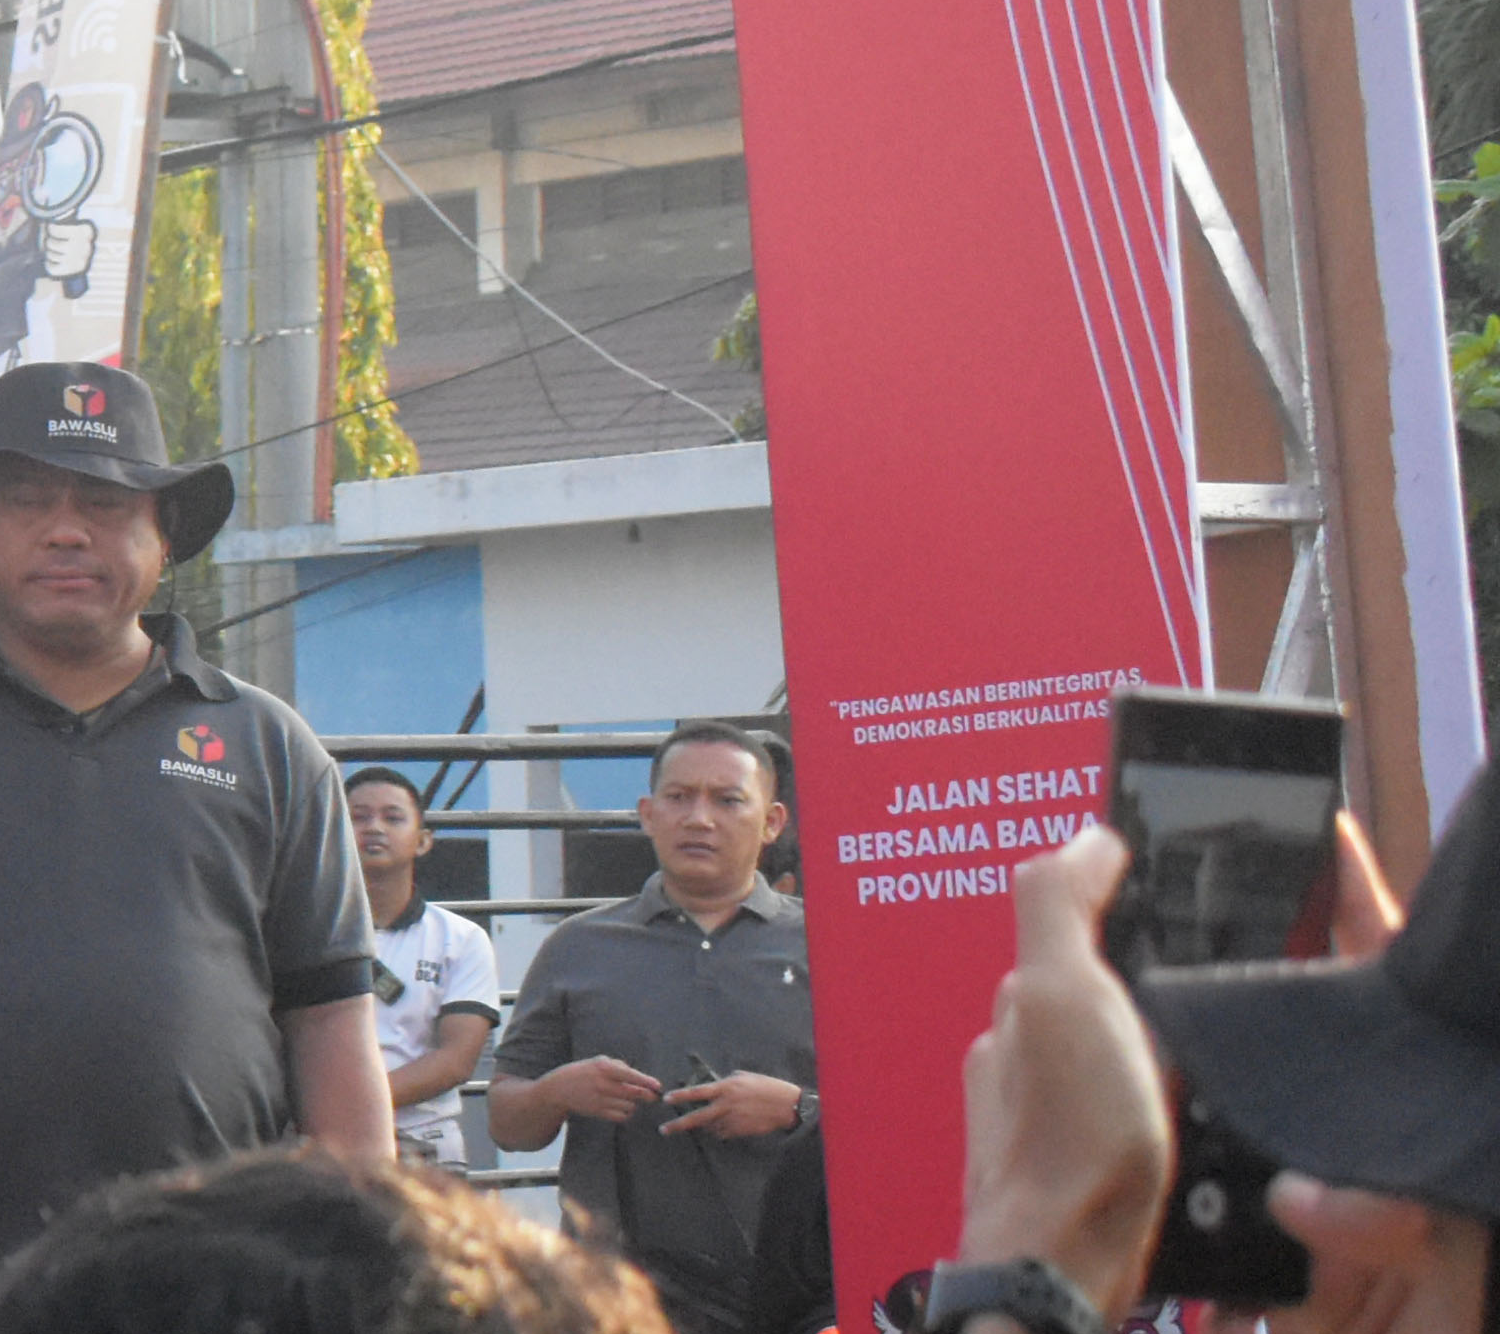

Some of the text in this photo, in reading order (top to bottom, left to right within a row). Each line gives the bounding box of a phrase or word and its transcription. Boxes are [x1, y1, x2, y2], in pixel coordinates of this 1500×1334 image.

[48, 419, 117, 438] BAWASLU
[854, 699, 1110, 745] DEMOKRASI BERKUALITAS
[160, 759, 237, 784] BAWASLU
[886, 766, 1101, 815] JALAN SEHAT
[838, 823, 990, 863] BERSAMA
[857, 865, 1009, 905] PROVINSI
